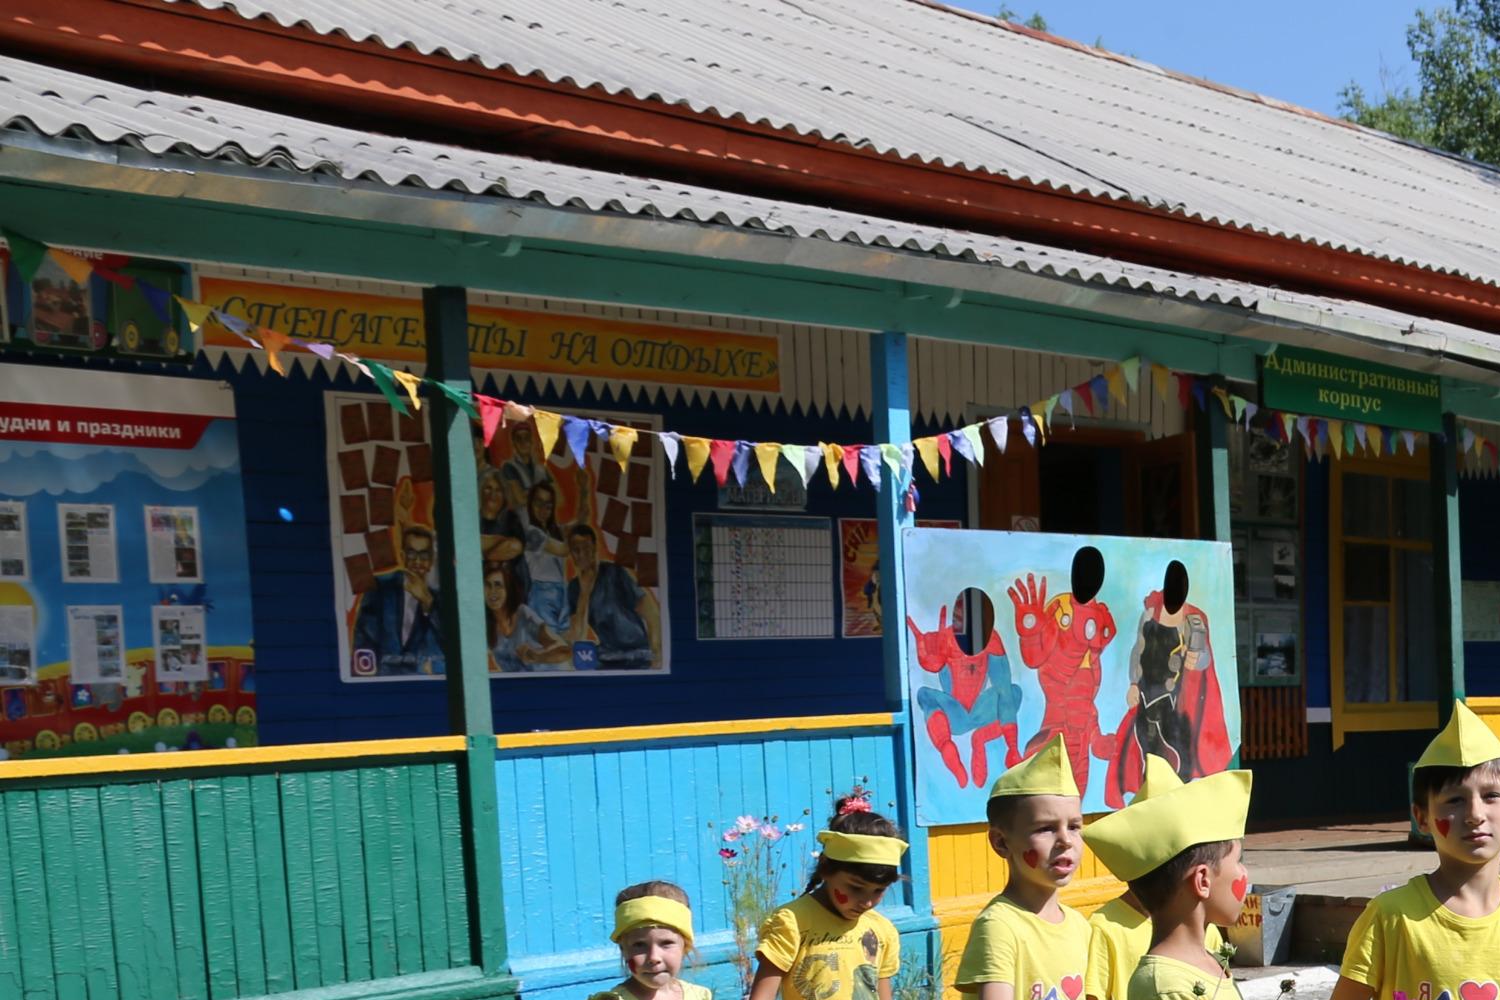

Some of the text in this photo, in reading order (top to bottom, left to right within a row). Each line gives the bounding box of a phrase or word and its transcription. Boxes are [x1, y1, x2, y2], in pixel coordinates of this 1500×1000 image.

[206, 296, 779, 379] «СПЕЦАГЕТЫ НА ОТДЫХЕ»
[1263, 352, 1440, 398] Административный
[1318, 388, 1382, 414] корпус
[57, 420, 70, 433] и
[77, 420, 183, 440] праздники
[1030, 983, 1042, 1000] Я
